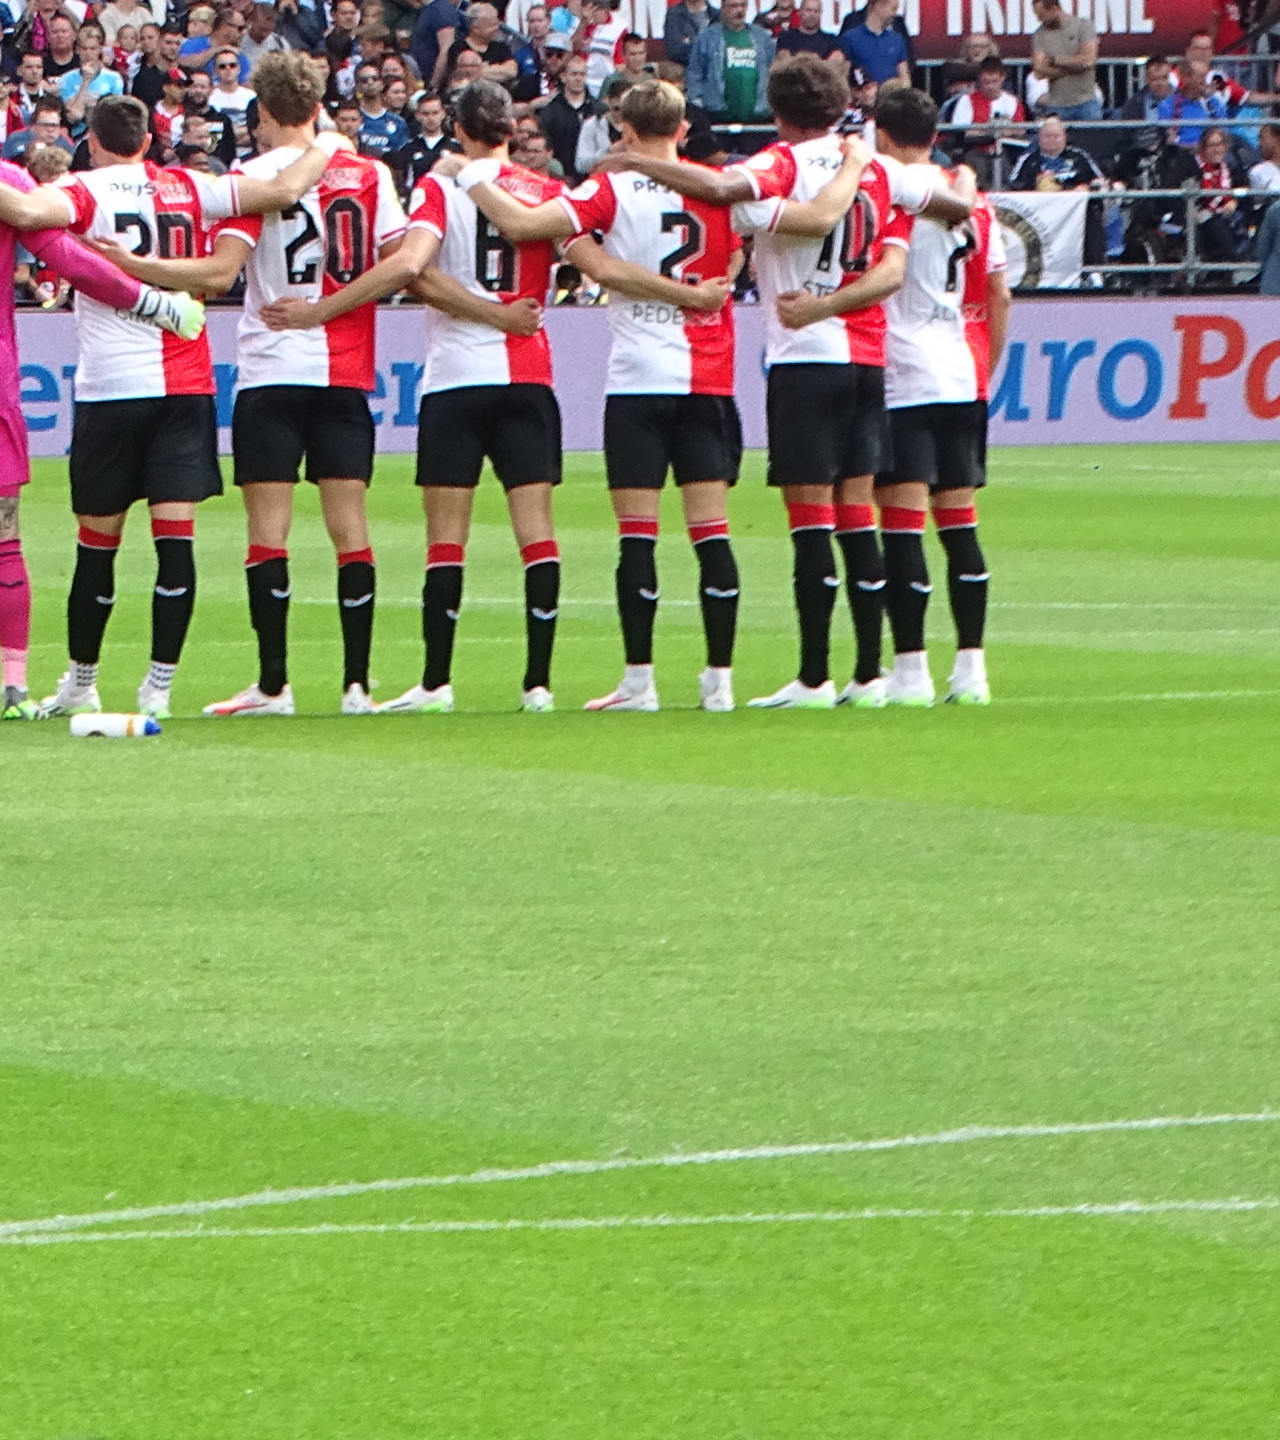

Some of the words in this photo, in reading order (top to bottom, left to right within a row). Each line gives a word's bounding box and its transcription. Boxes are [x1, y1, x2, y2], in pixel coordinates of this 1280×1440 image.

[281, 197, 366, 285] 20
[475, 207, 520, 294] 6
[660, 211, 707, 288] 2
[816, 192, 880, 273] 10
